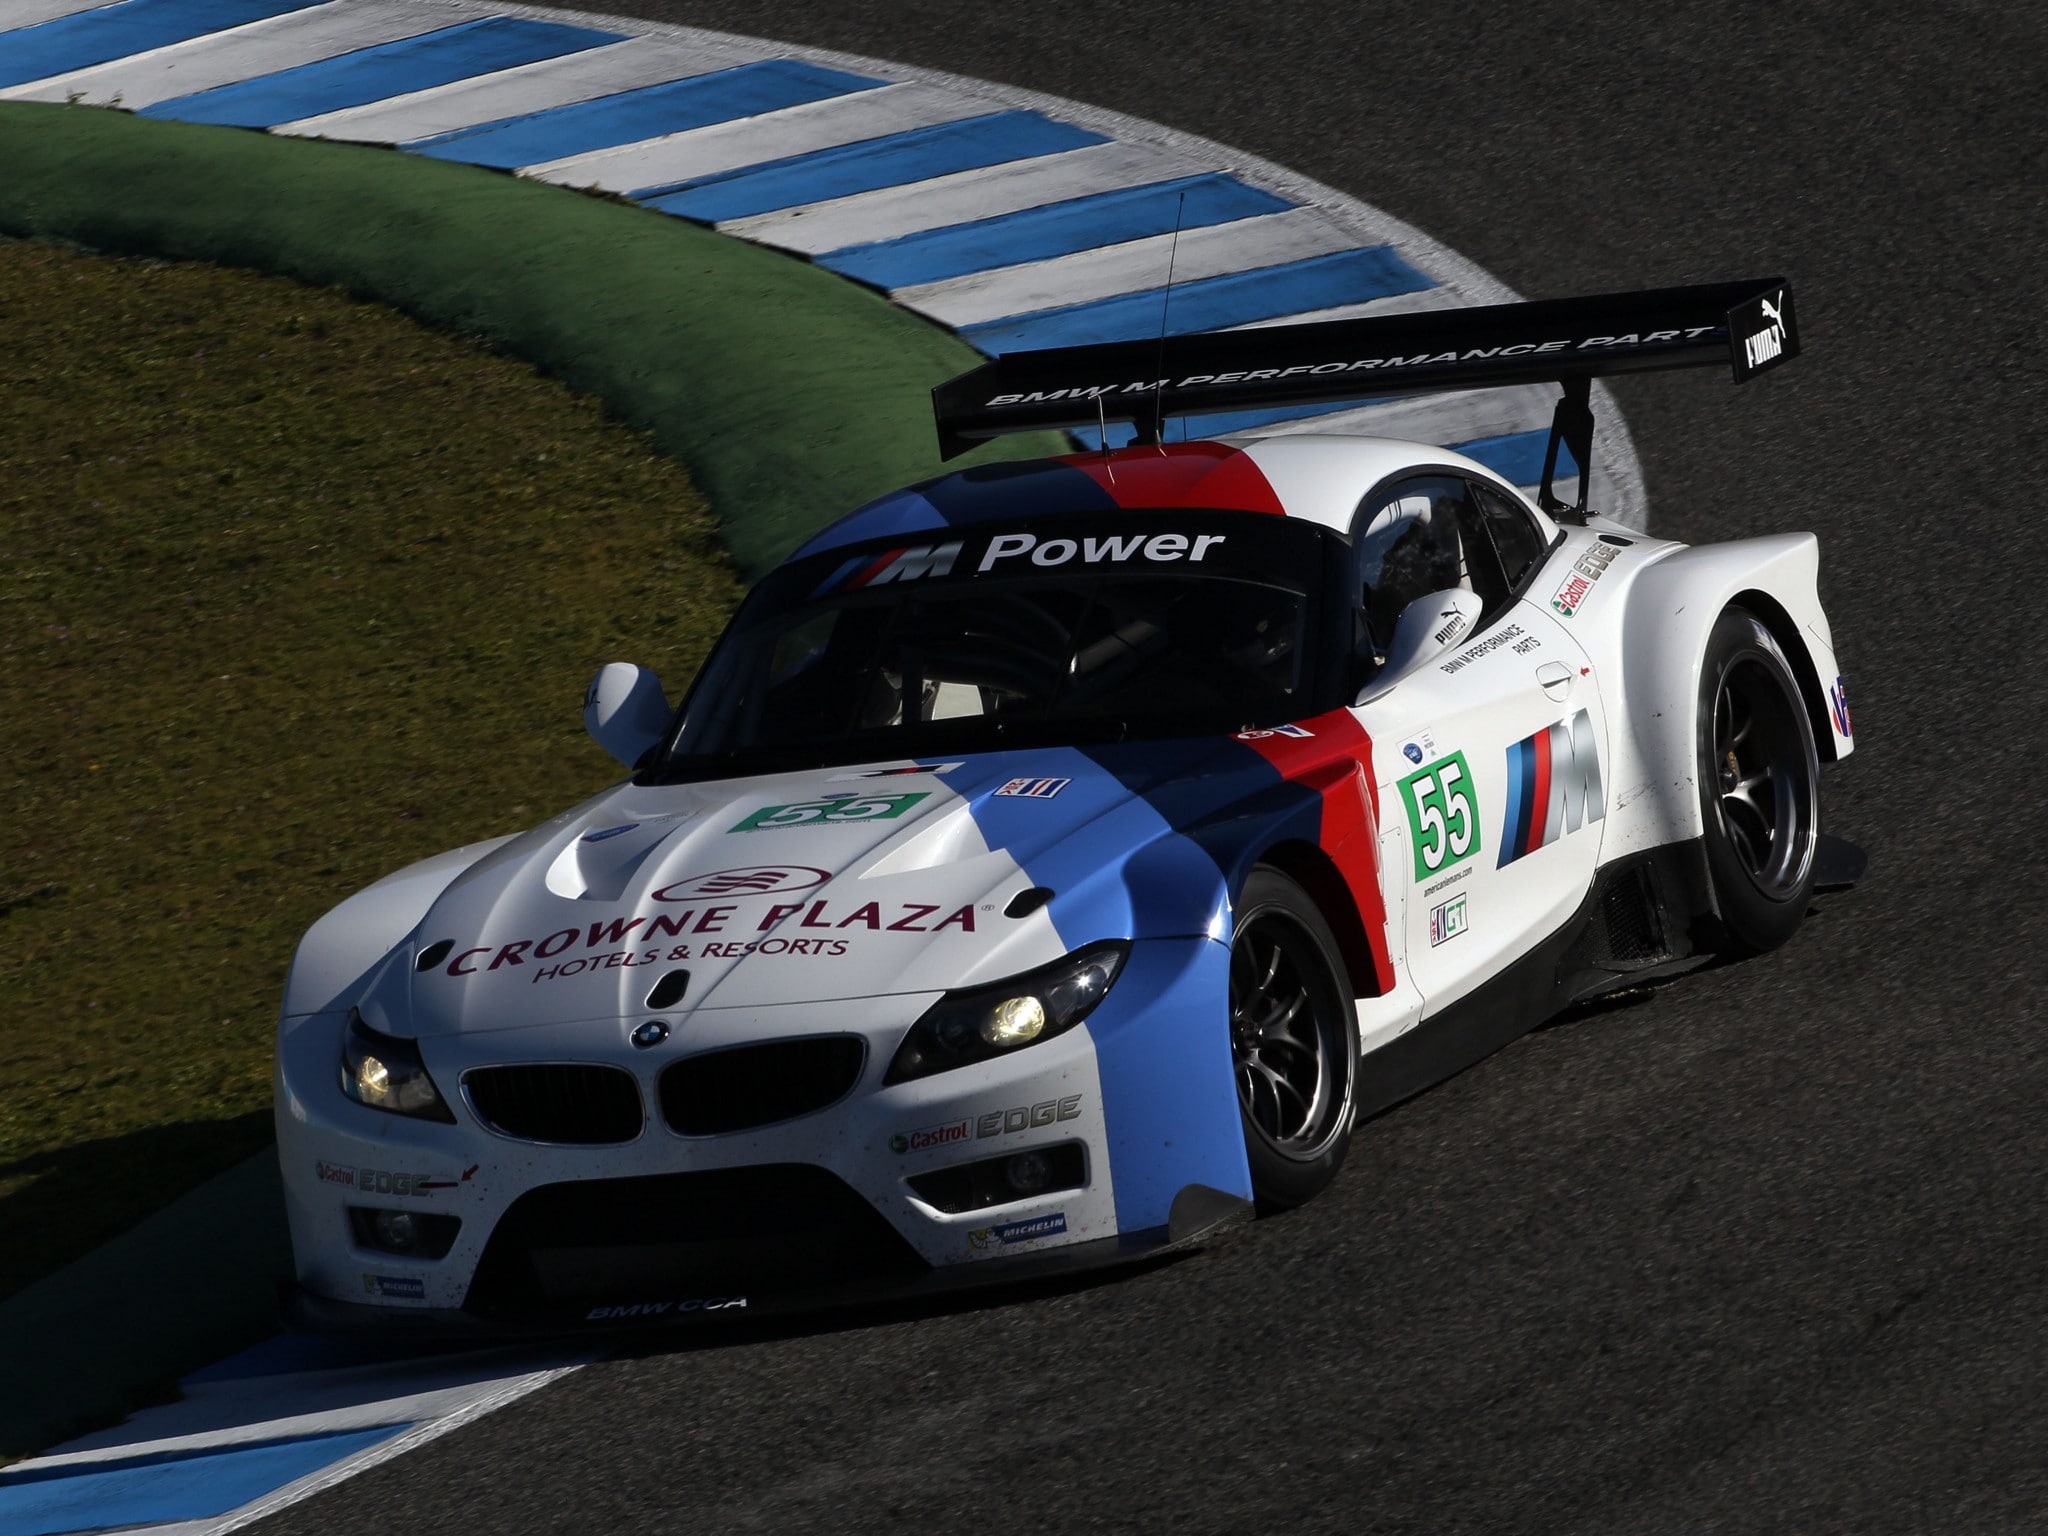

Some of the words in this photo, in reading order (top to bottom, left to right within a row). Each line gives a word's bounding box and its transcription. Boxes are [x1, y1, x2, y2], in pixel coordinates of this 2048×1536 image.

[1744, 324, 1782, 369] PUMA
[985, 384, 1119, 407] BMW
[1121, 379, 1170, 394] M
[1177, 341, 1569, 388] PERFORMANCE
[977, 533, 1225, 573] Power
[1574, 542, 1622, 581] EDGE
[1561, 575, 1590, 609] Castrol
[1434, 615, 1467, 646] PUMA
[1439, 658, 1465, 674] BMW
[1465, 623, 1525, 661] PERFORMANCE
[1511, 636, 1541, 656] PARTS
[756, 793, 907, 828] 55
[1411, 760, 1472, 871] 55
[1447, 900, 1466, 932] GT
[446, 904, 737, 977] CROWNE
[532, 948, 660, 983] HOTELS
[666, 944, 691, 961] &
[700, 938, 850, 959] RESORTS
[911, 1122, 967, 1149] Castrol
[977, 1094, 1082, 1139] EDGE
[324, 1165, 355, 1186] Castrol
[359, 1168, 431, 1196] EDGE
[1003, 1218, 1064, 1238] MICHELIN
[383, 1281, 422, 1293] MICHELIN
[585, 1302, 673, 1320] BMW
[678, 1297, 747, 1312] CCA
